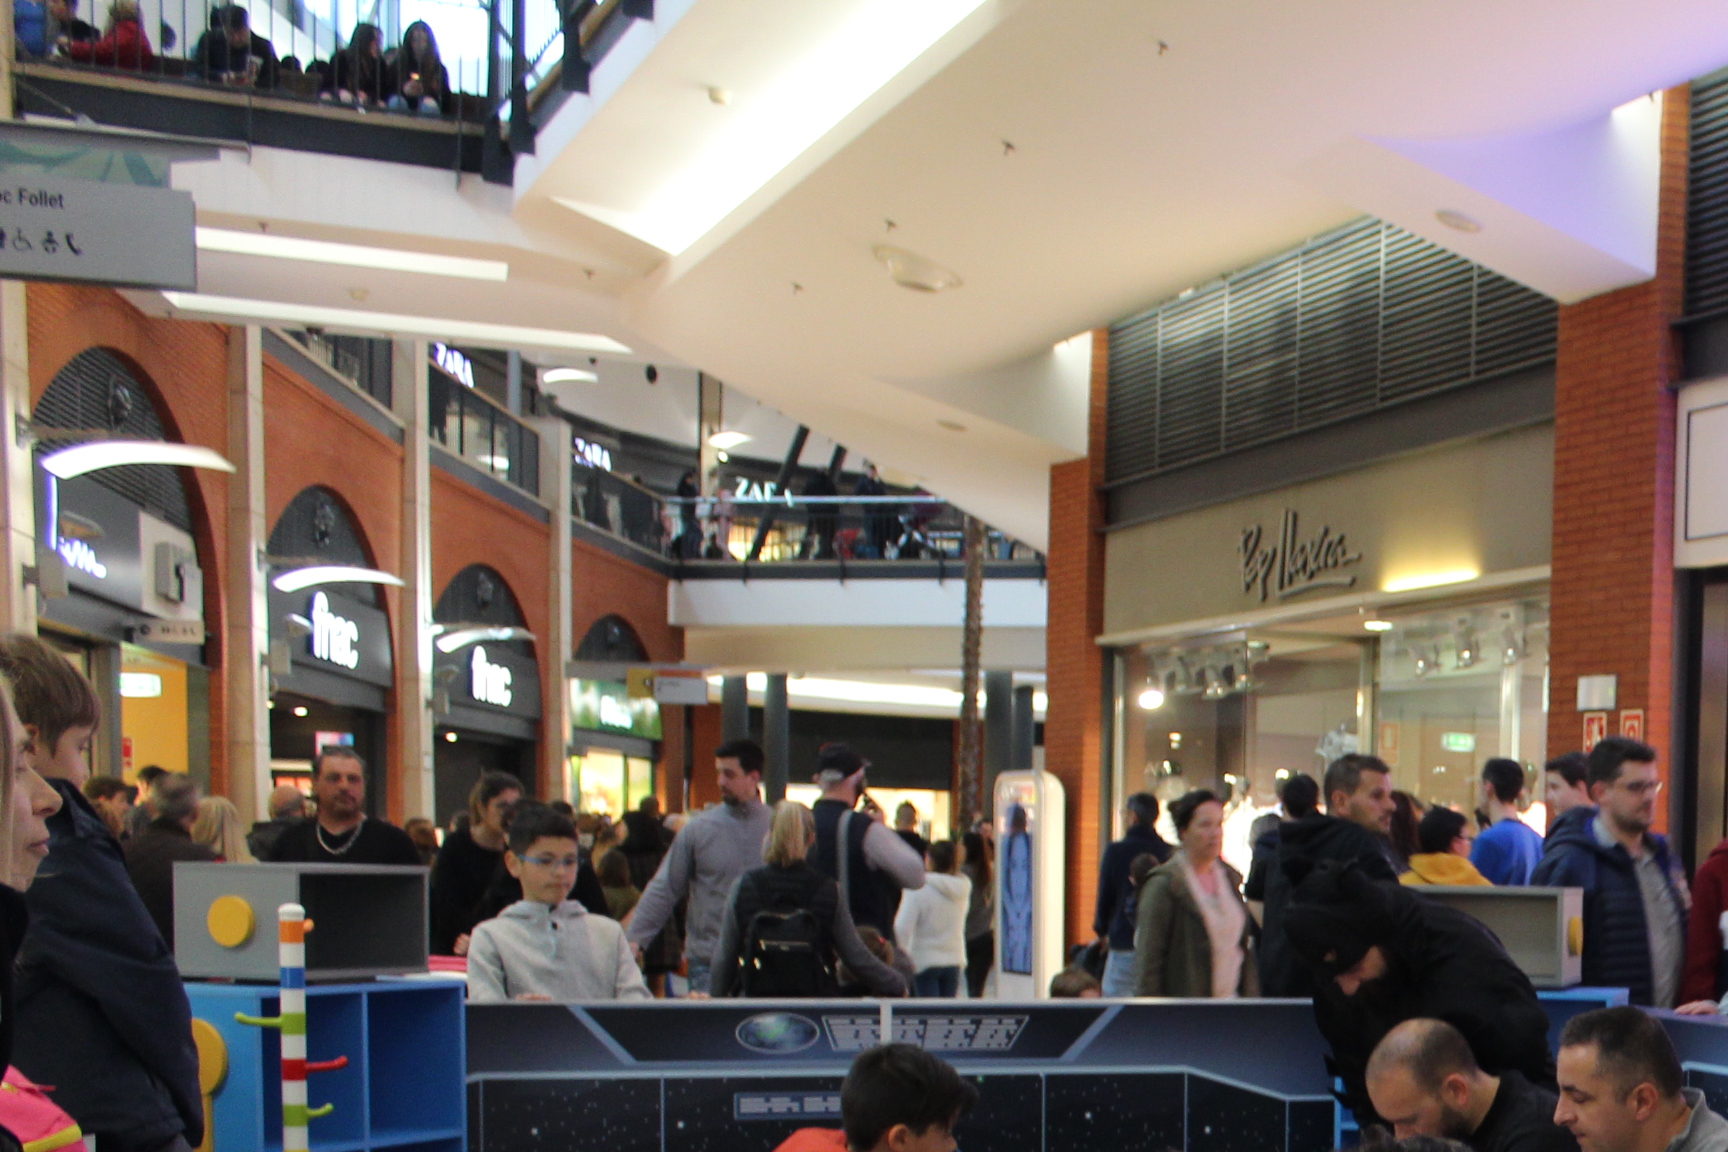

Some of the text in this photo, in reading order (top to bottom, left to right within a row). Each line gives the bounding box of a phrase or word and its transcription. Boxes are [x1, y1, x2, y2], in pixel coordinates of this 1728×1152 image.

[19, 187, 64, 209] Follet
[434, 342, 474, 389] ZARA
[574, 437, 612, 472] ZARA
[312, 591, 359, 670] fnac
[471, 645, 512, 708] fnac
